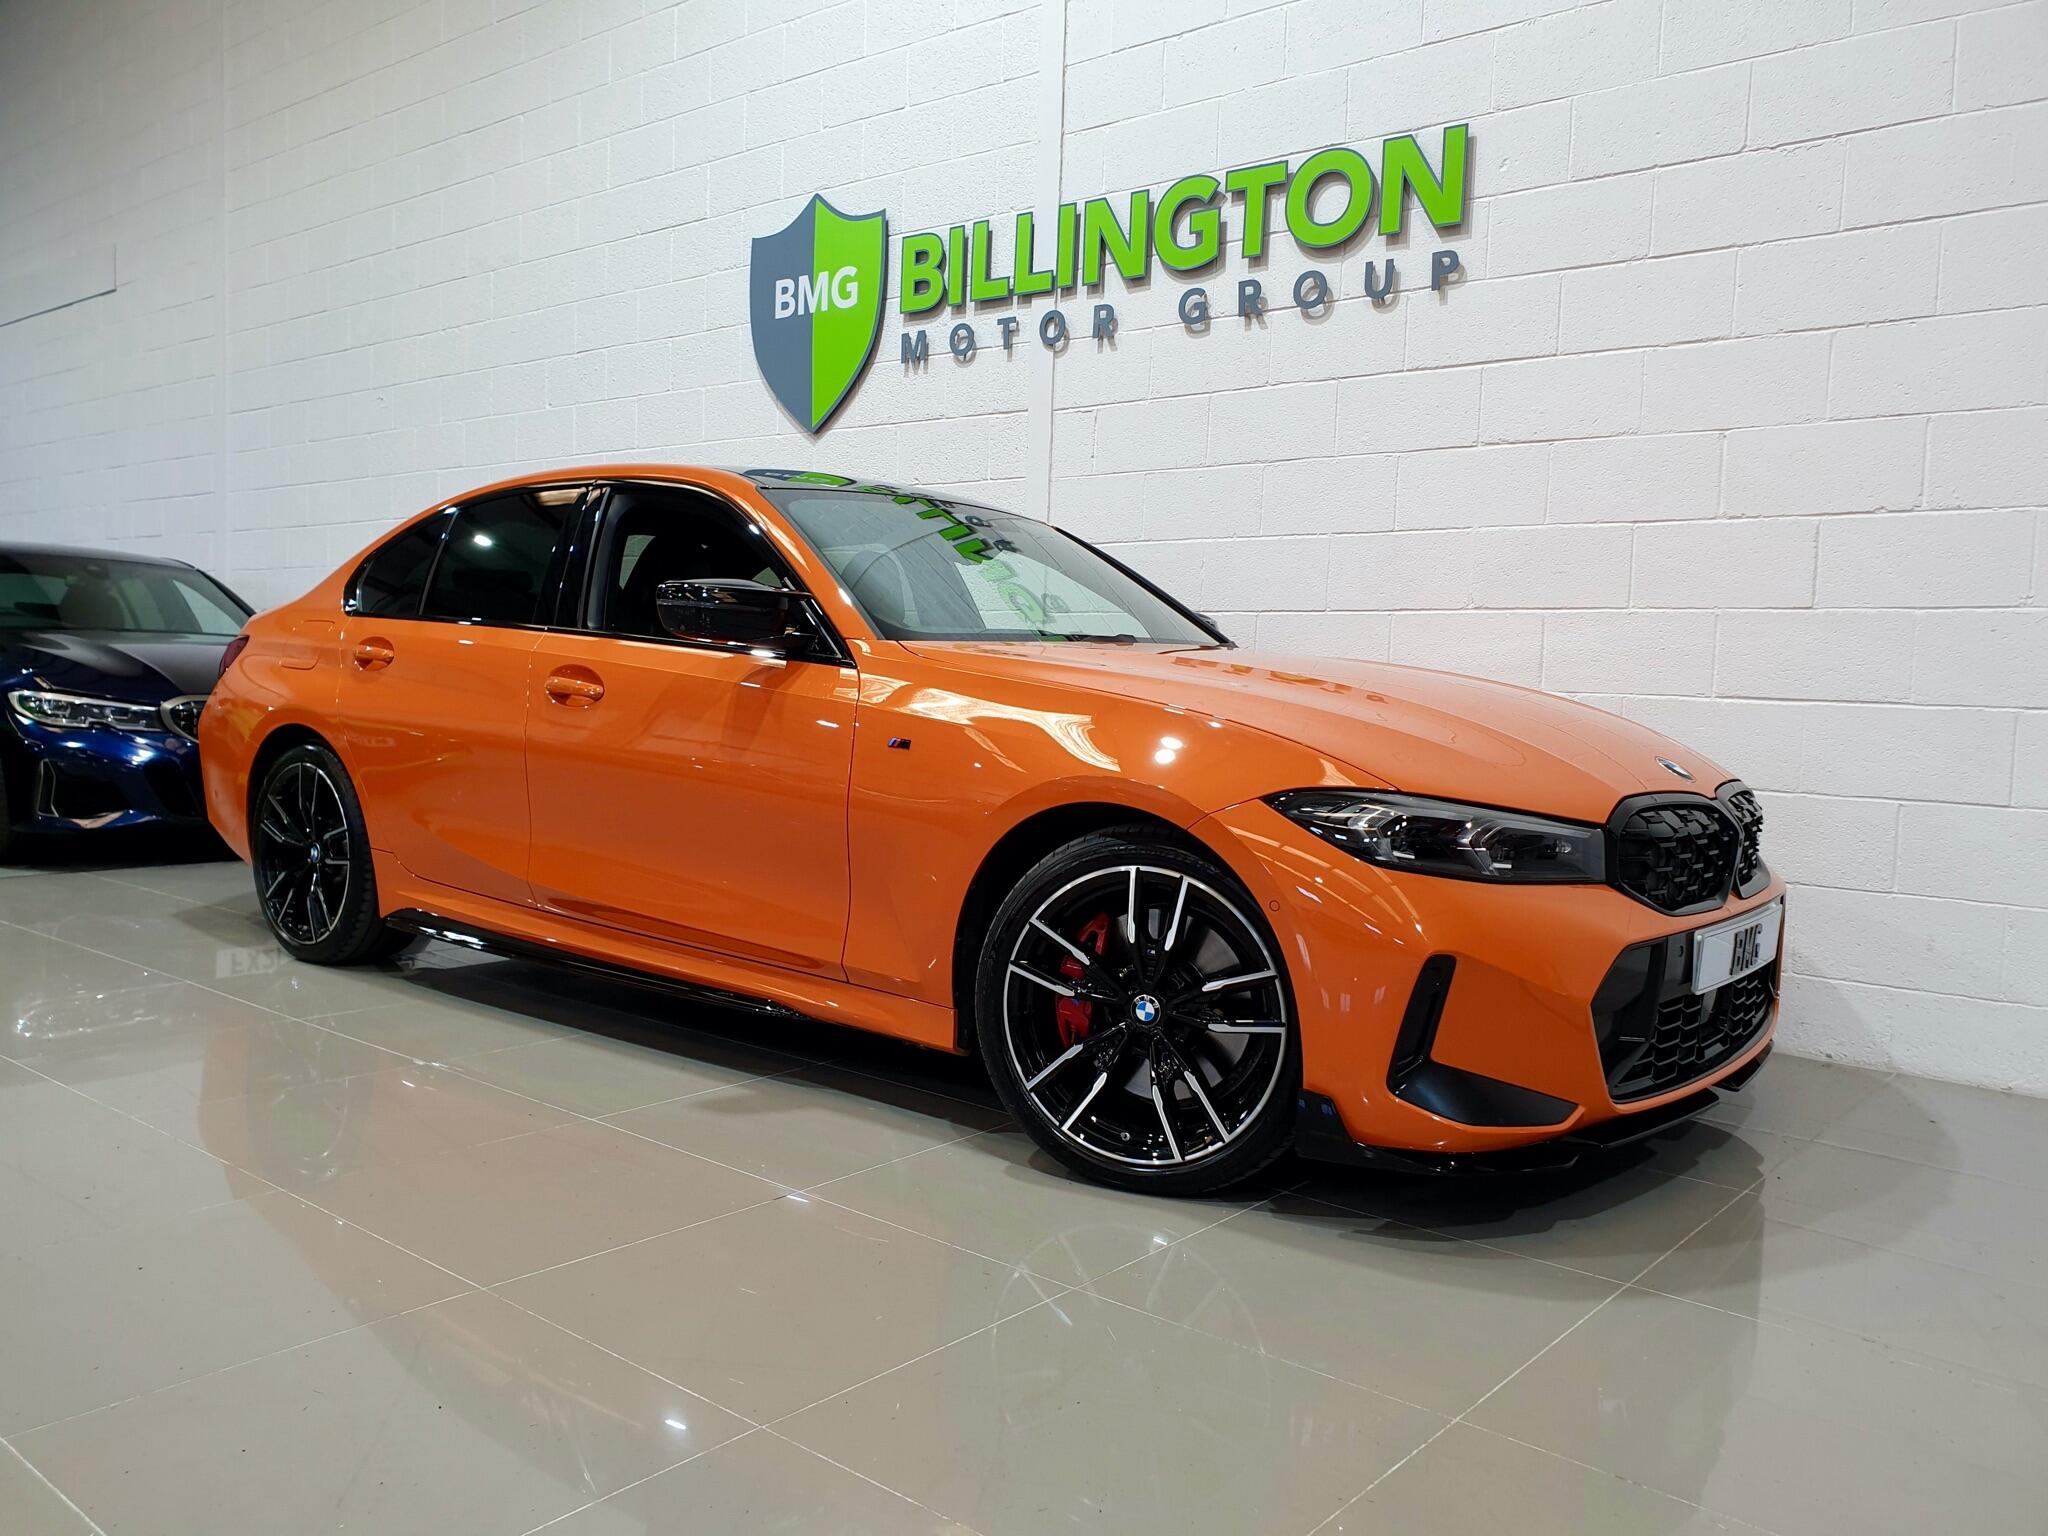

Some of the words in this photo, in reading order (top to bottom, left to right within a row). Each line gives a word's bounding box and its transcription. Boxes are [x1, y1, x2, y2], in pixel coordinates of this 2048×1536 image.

[900, 124, 1469, 314] BILLINGTON
[775, 265, 859, 320] BMG
[901, 303, 1115, 364] MOTOR
[1178, 249, 1460, 325] GROUP
